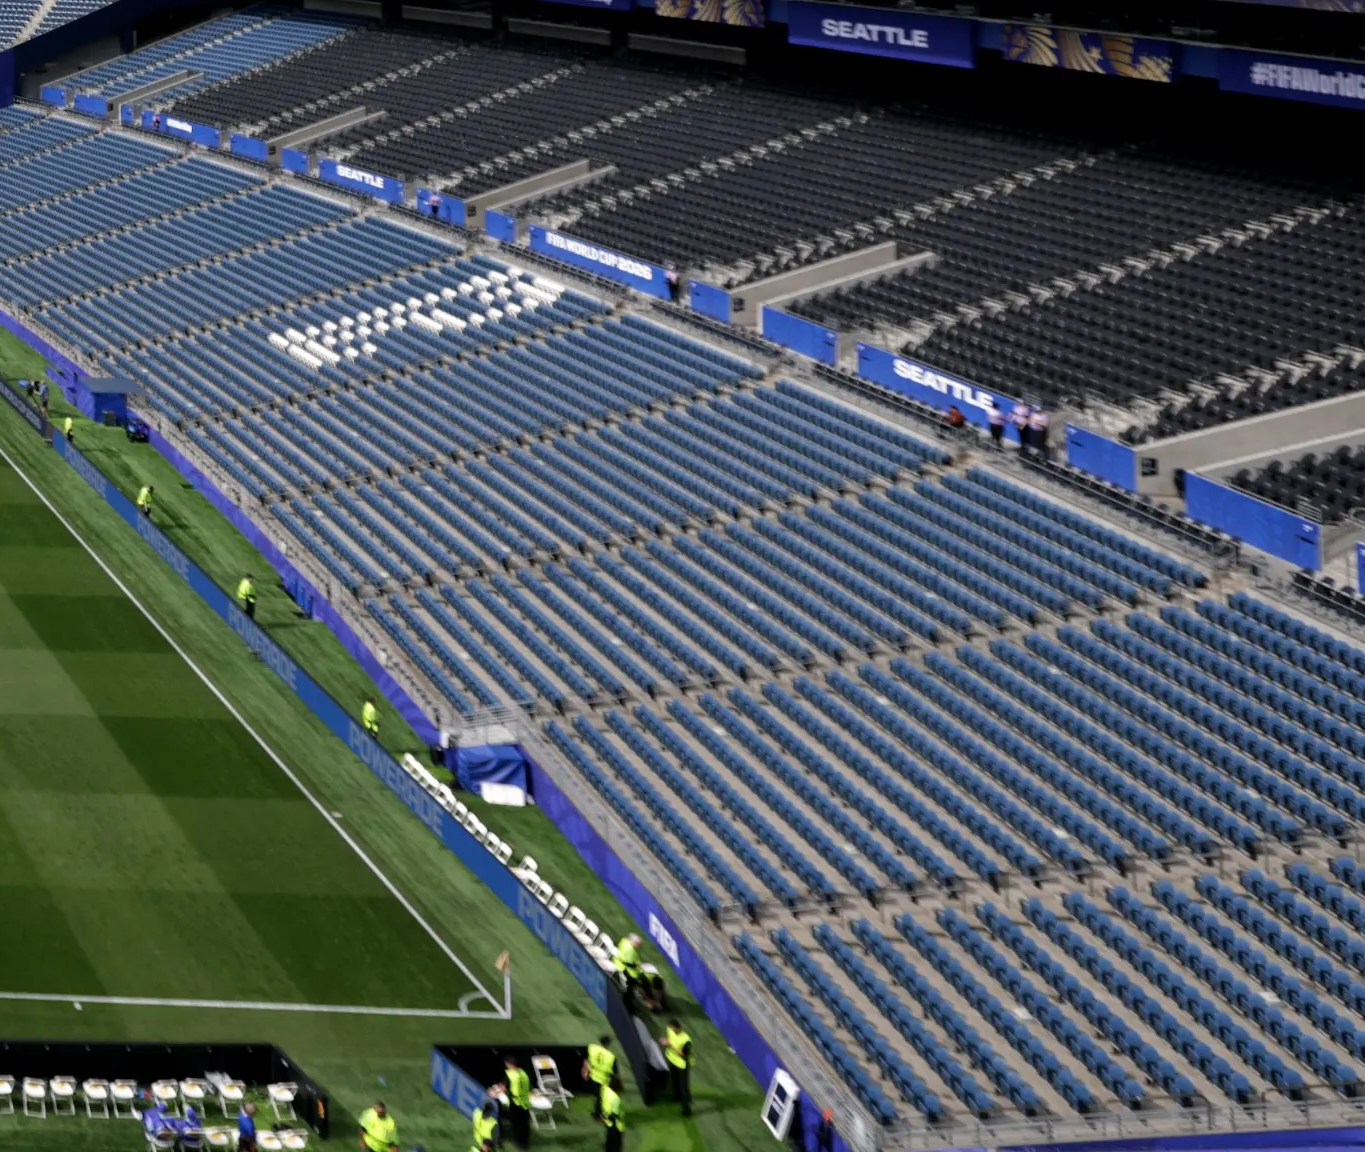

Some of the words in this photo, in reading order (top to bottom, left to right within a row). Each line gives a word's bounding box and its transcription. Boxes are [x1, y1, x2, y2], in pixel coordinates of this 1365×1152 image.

[820, 16, 930, 49] SEATTLE
[335, 164, 385, 189] SEATTLE
[545, 231, 567, 251] FIFA
[566, 238, 599, 261] WORLD
[598, 250, 618, 268] CUP
[617, 255, 653, 281] 2026
[892, 358, 996, 412] SEATTLE
[349, 720, 444, 839] POWERADE
[649, 911, 681, 968] FIFA
